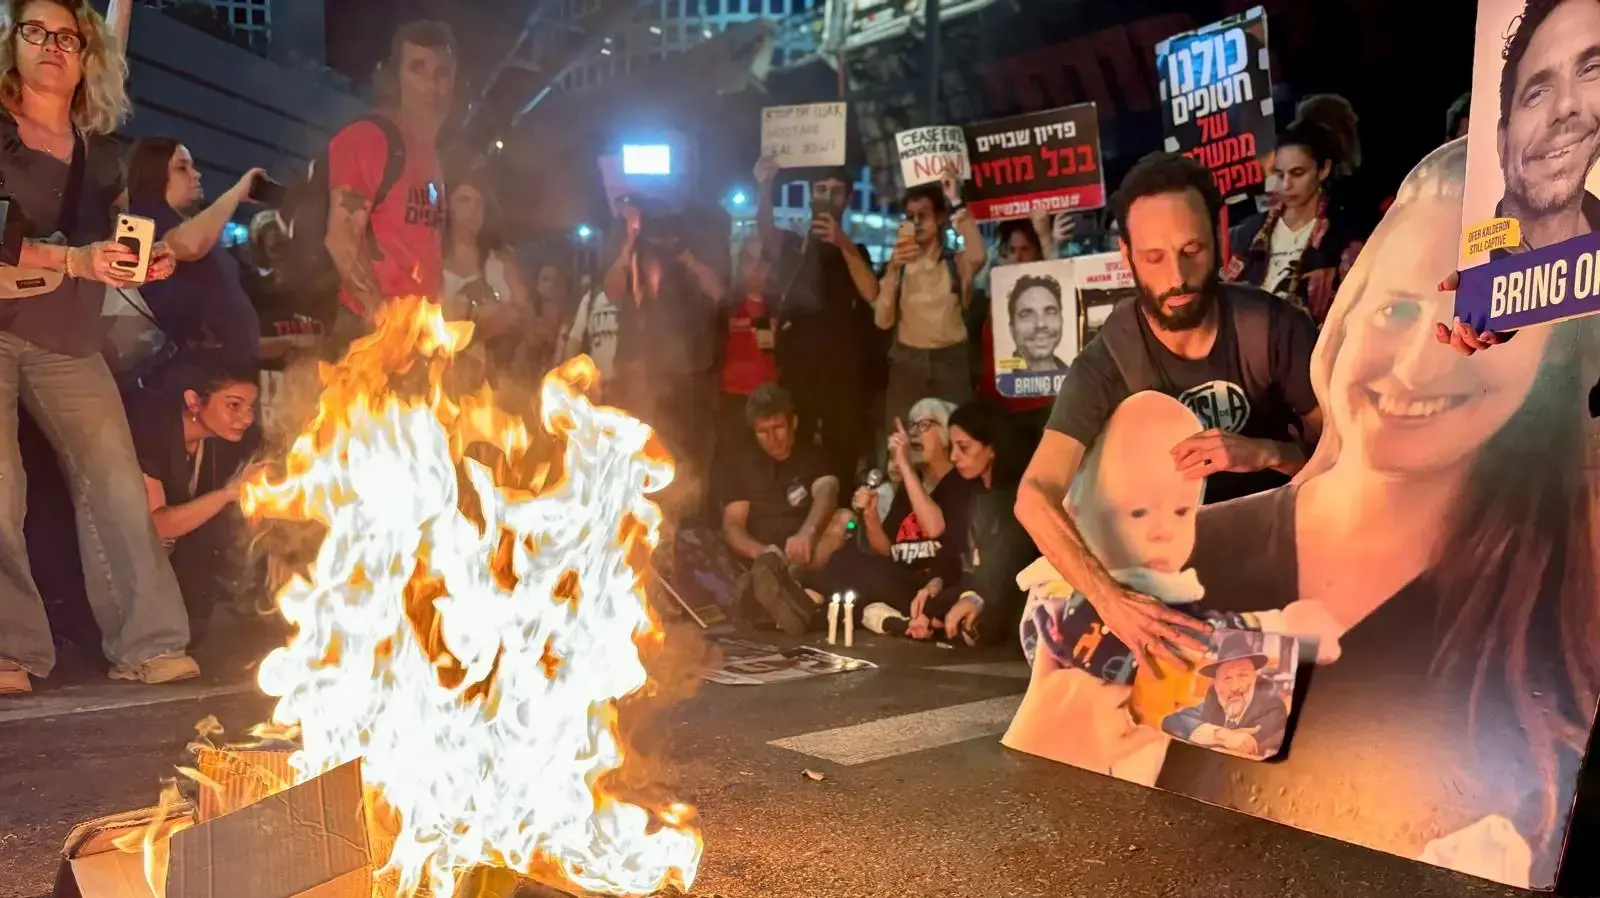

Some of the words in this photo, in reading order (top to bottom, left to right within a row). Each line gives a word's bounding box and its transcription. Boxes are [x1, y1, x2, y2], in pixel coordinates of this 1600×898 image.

[1168, 27, 1248, 97] כולנו
[1171, 71, 1253, 126] חטופים
[976, 128, 1031, 153] שבויים
[1034, 121, 1077, 146] פדיון
[1196, 111, 1229, 143] של
[1041, 144, 1097, 177] בכל
[1181, 132, 1256, 168] ממשל
[1468, 229, 1482, 243] OFER
[1482, 220, 1511, 238] KALDERON
[1469, 242, 1483, 255] STILL
[1484, 233, 1507, 251] CAPTIVE
[1490, 259, 1568, 319] BRING
[1014, 375, 1051, 394] BRING
